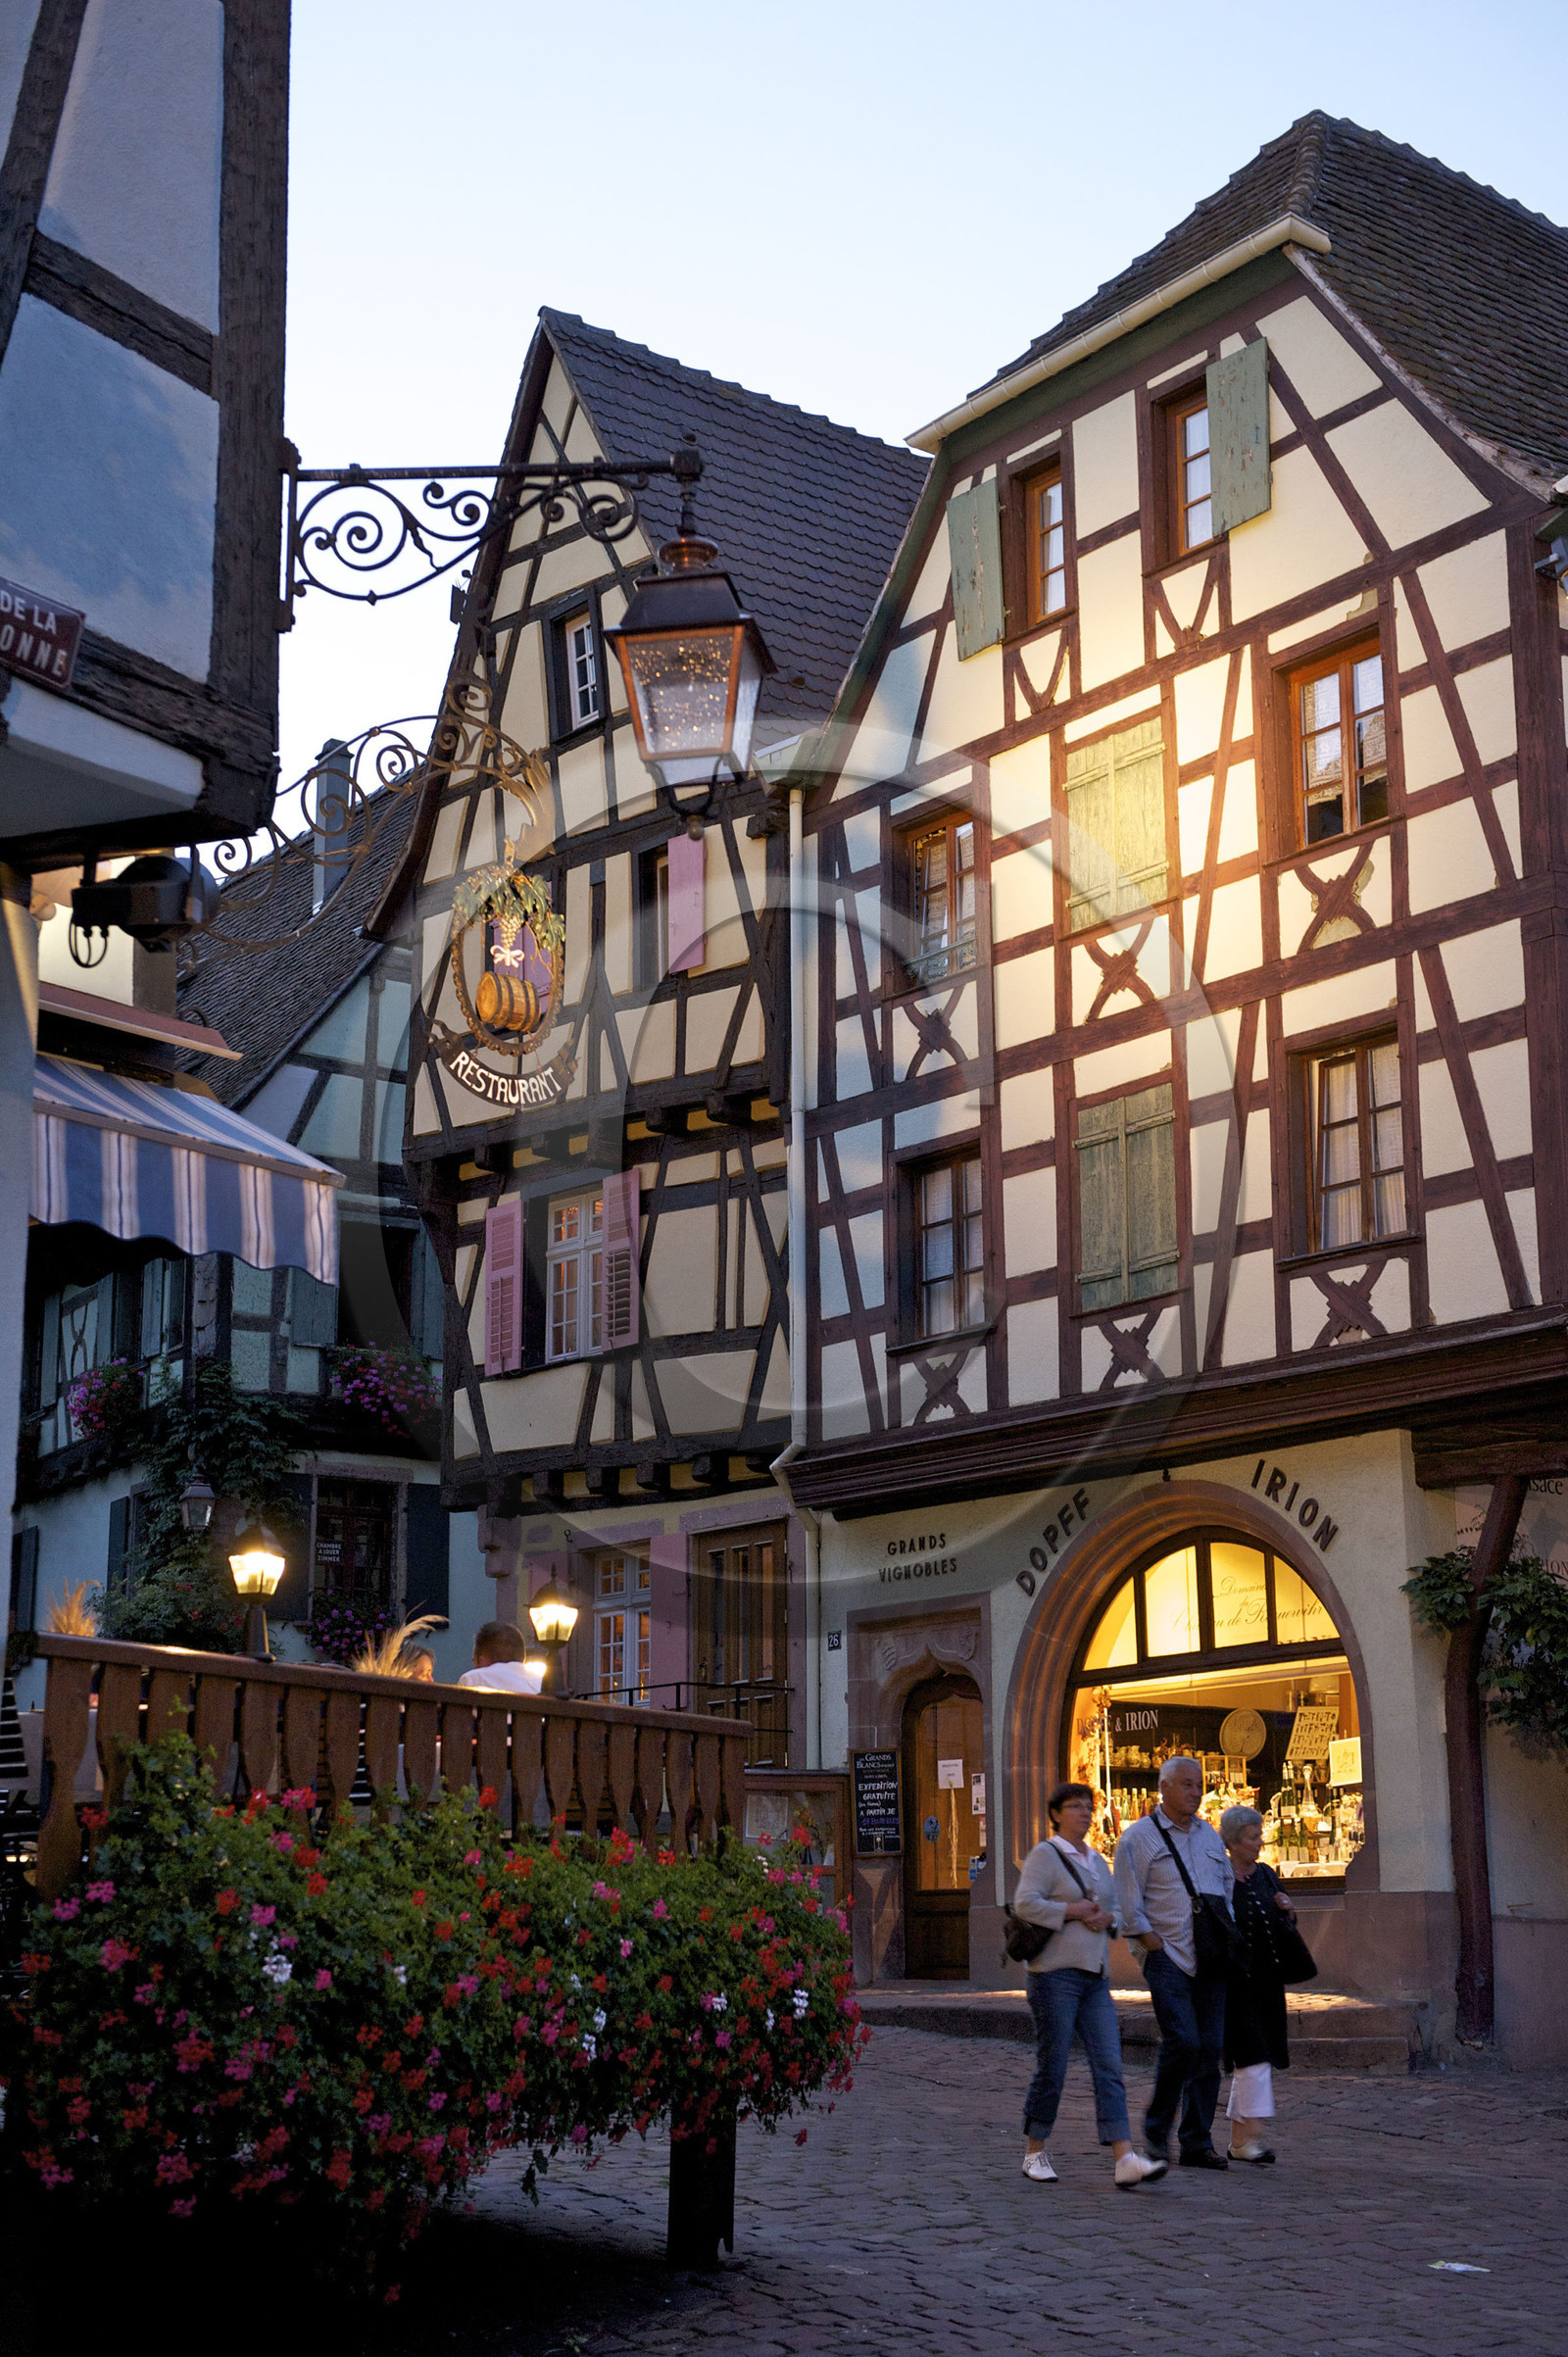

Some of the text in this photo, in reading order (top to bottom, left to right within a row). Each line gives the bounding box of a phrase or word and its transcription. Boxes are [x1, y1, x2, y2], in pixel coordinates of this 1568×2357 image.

[0, 590, 57, 635] DE LA
[449, 1051, 562, 1105] RESTAURANT
[1015, 1488, 1090, 1596] DOPFF
[1250, 1458, 1339, 1551] IRION
[887, 1533, 947, 1556] GRANDS
[878, 1557, 957, 1583] VIGNOBLES
[1227, 1607, 1242, 1627] de
[1245, 1597, 1323, 1625] Riuewihr
[828, 1634, 839, 1647] 26
[1114, 1717, 1122, 1733] &
[1125, 1709, 1158, 1732] IRION
[862, 1792, 896, 1800] GRATUITE
